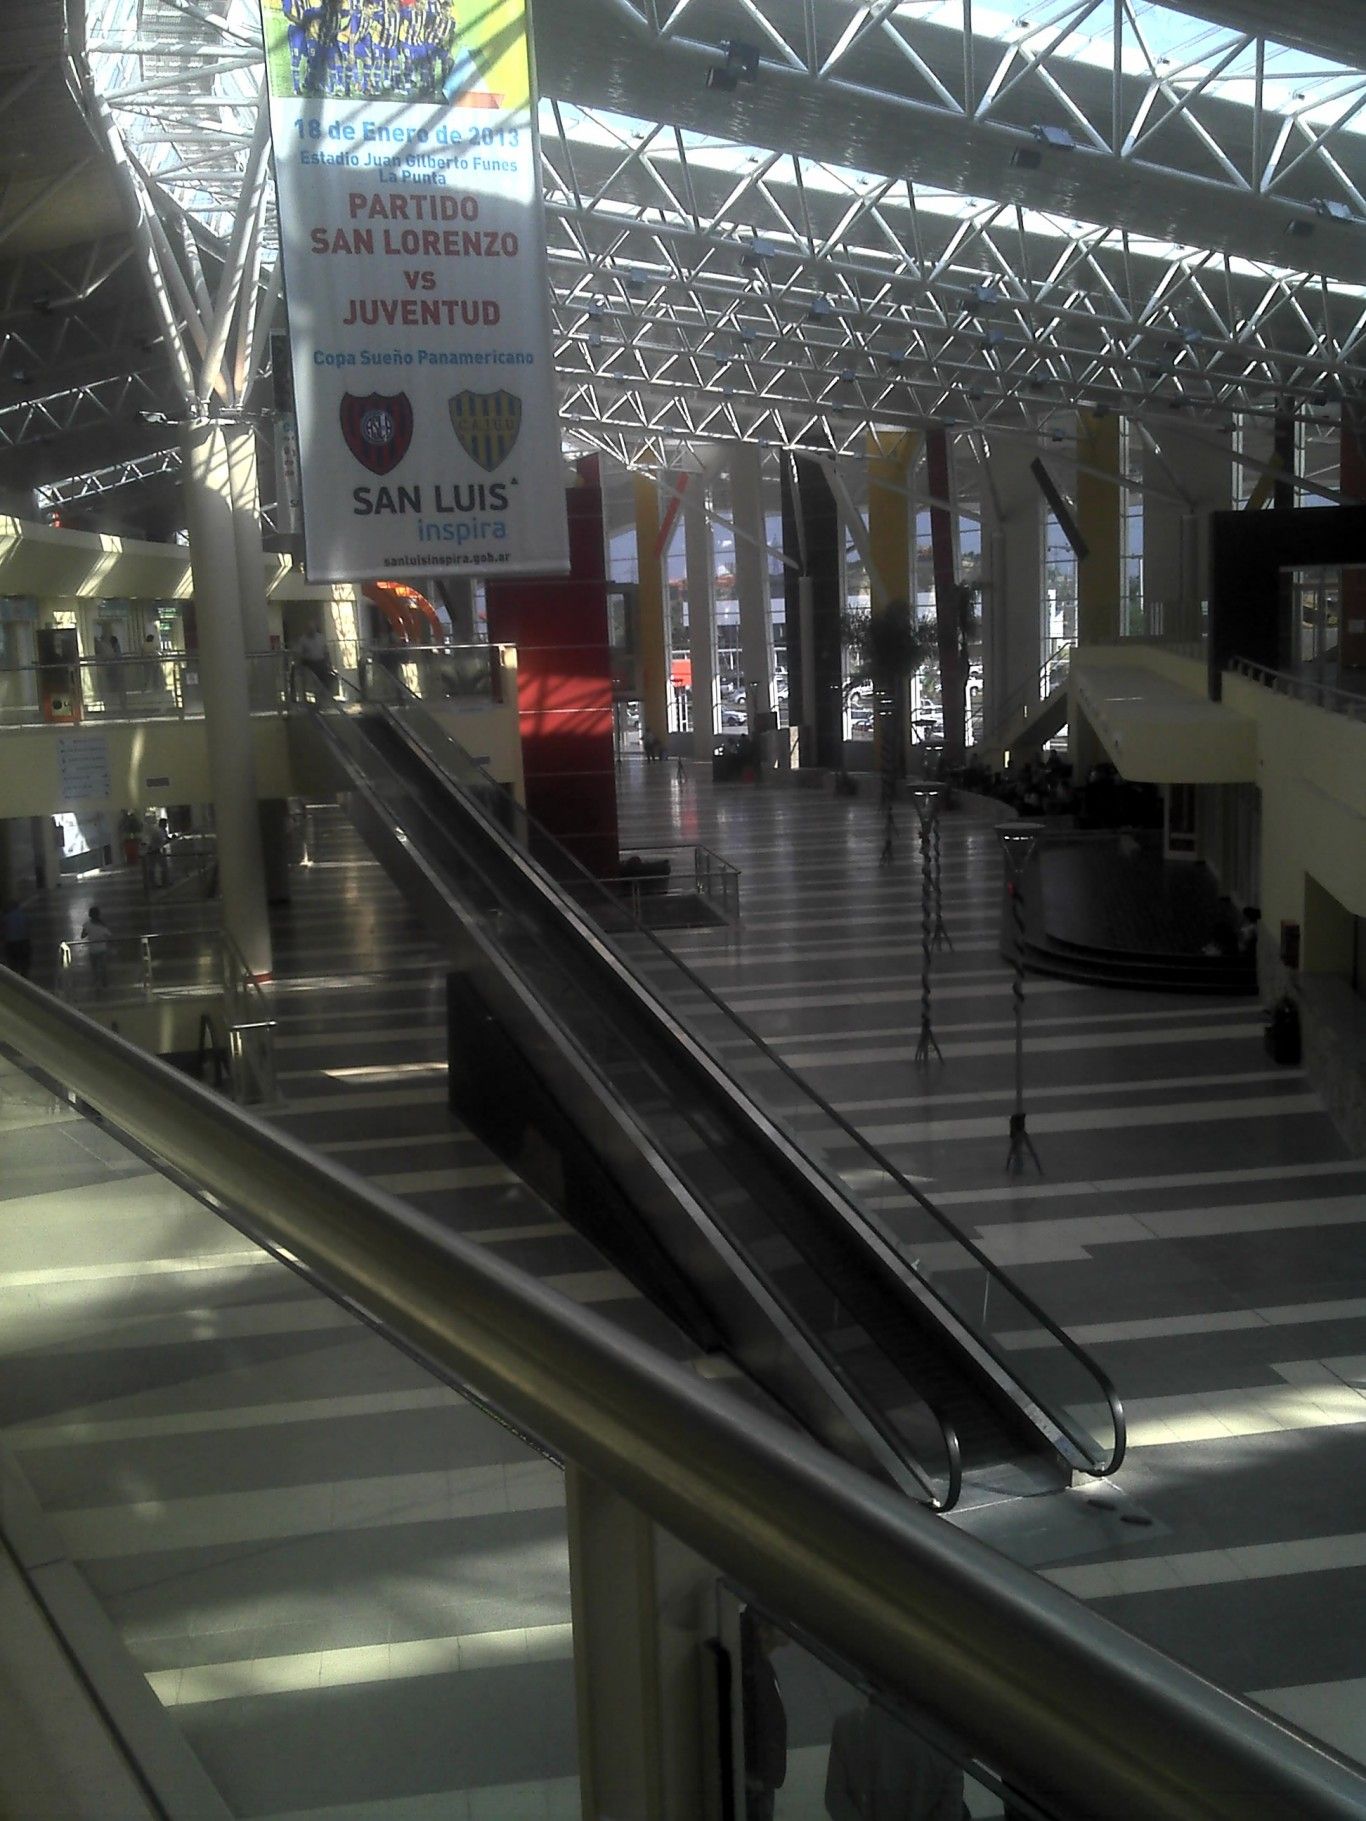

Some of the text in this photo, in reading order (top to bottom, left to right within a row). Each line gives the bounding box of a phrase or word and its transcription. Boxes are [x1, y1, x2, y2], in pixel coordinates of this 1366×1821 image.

[294, 118, 519, 148] 18 de Enero de 2013
[300, 151, 519, 172] Estadio Juan Gilberto Funes
[379, 169, 447, 185] La Punta
[348, 192, 479, 222] PARTIDO
[310, 227, 520, 257] SAN LORENZO
[343, 299, 501, 326] JUVENTUD
[313, 348, 534, 368] Copa Sueño Panamericano
[352, 483, 509, 516] SAN LUIS
[417, 516, 507, 546] inspira
[383, 552, 512, 568] sanluisinspira.gob.ar
